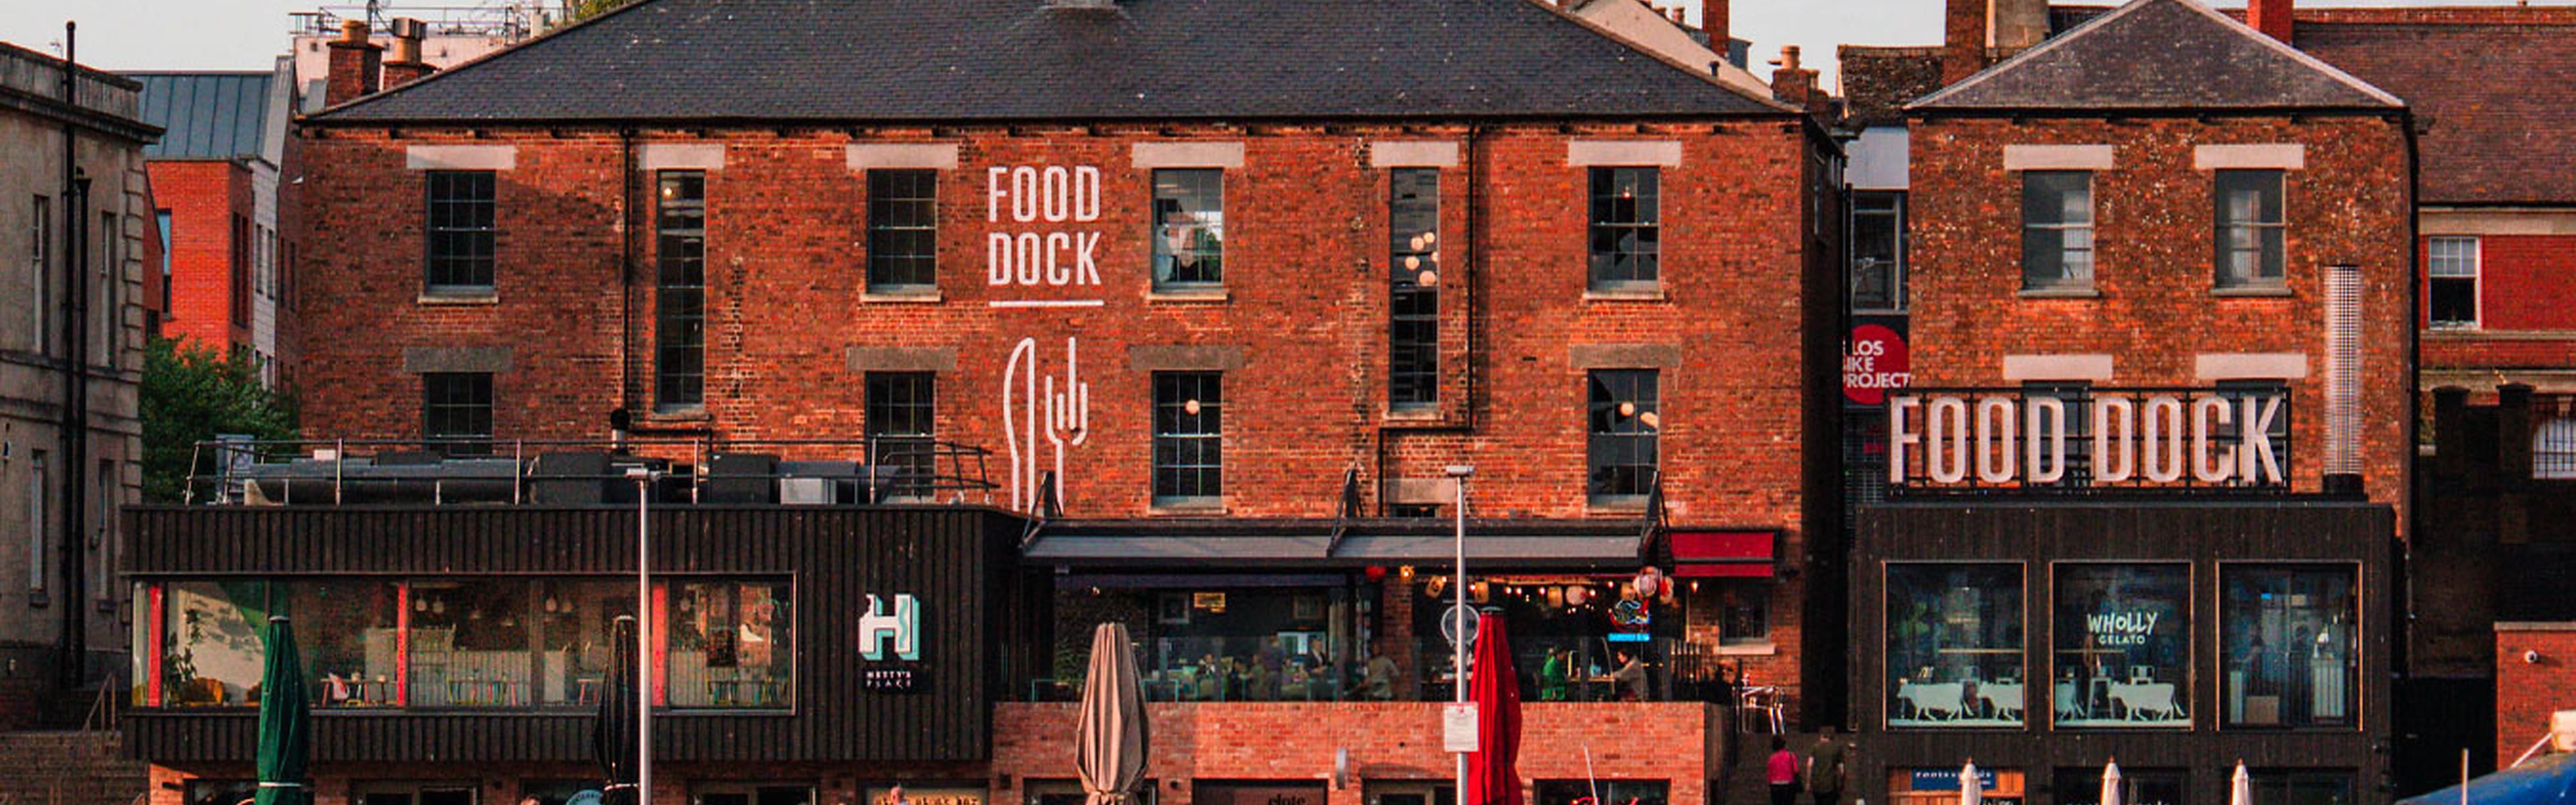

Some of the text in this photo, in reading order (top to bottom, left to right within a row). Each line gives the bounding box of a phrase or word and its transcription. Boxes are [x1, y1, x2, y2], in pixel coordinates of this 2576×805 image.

[988, 166, 1100, 222] FOOD
[988, 231, 1101, 285] DOCK
[1842, 339, 1884, 356] LOS
[1842, 356, 1874, 372] IKE
[1842, 372, 1910, 388] ROJECT
[1890, 395, 2284, 484] FOOD DOCK
[2086, 611, 2158, 635] WHOLLY
[2098, 634, 2145, 645] GELATO
